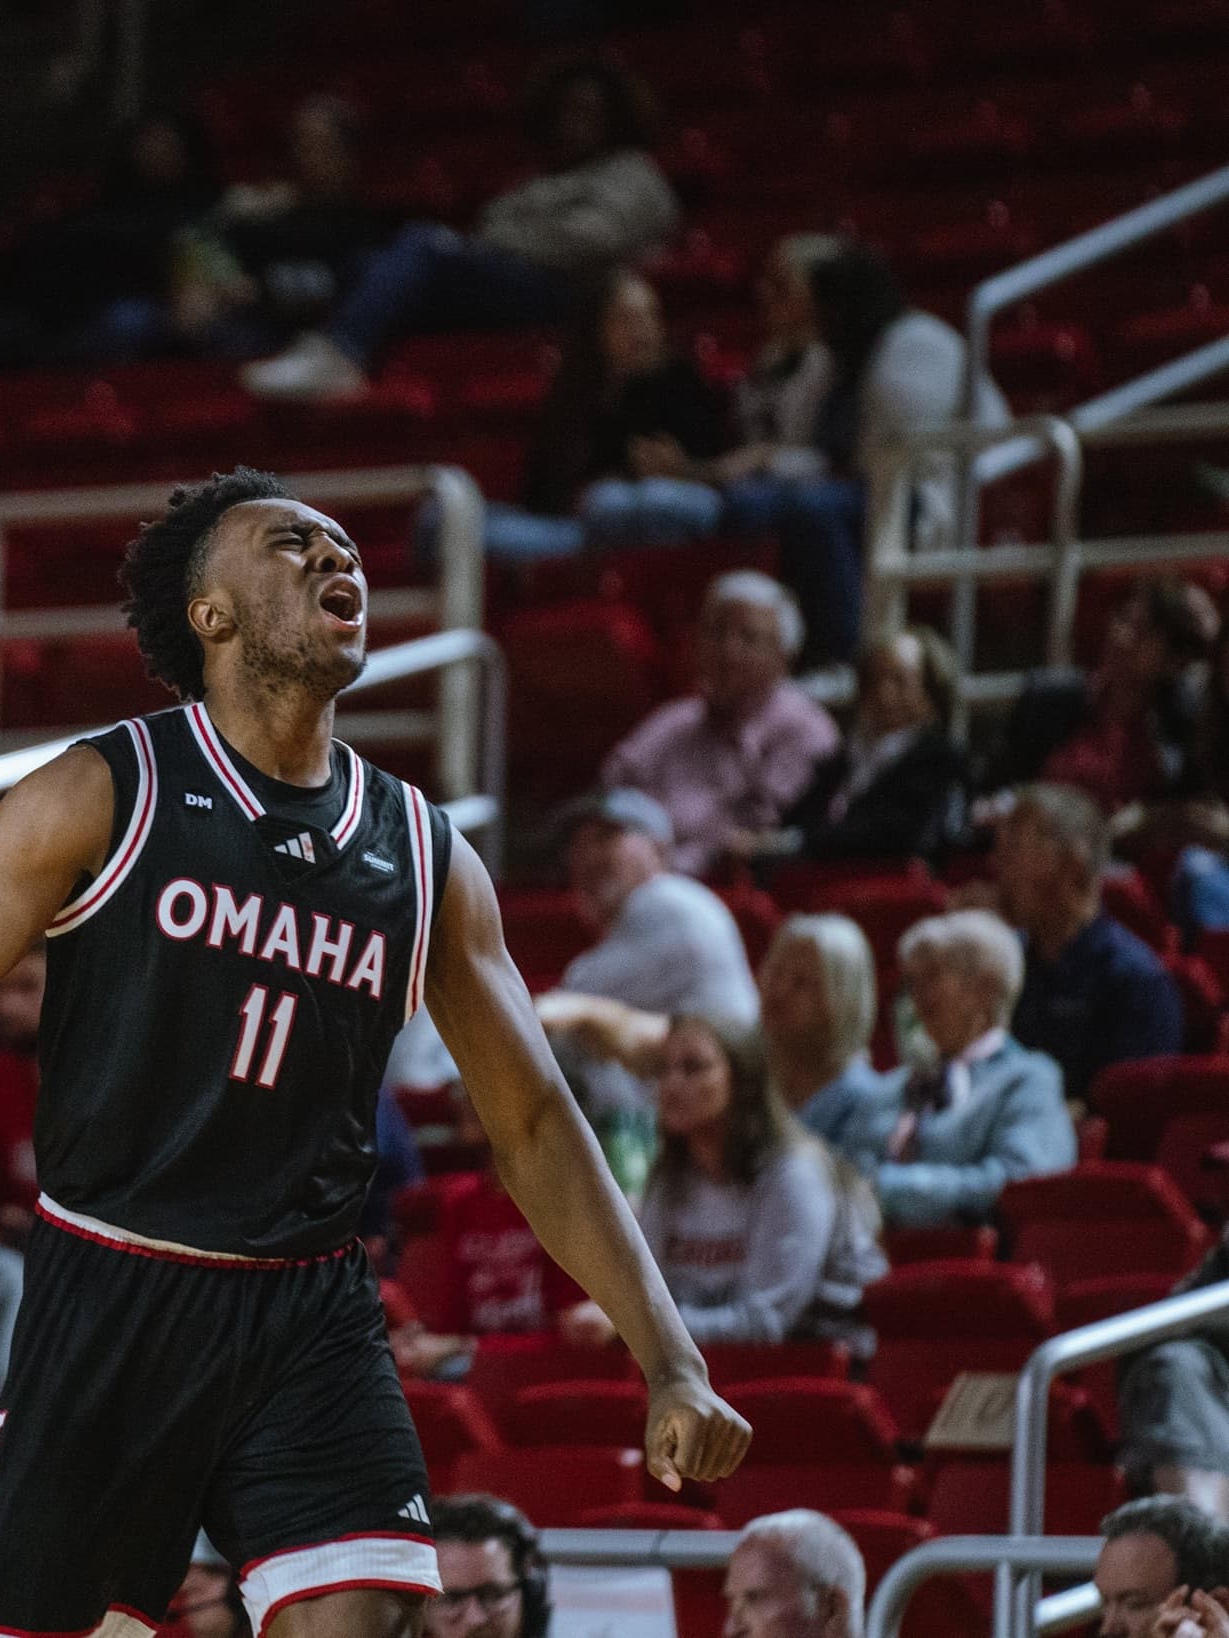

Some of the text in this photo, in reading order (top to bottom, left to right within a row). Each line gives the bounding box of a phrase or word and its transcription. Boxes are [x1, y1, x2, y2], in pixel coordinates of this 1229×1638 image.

[185, 793, 212, 809] DM
[155, 878, 386, 999] OMAHA
[230, 984, 298, 1088] 11
